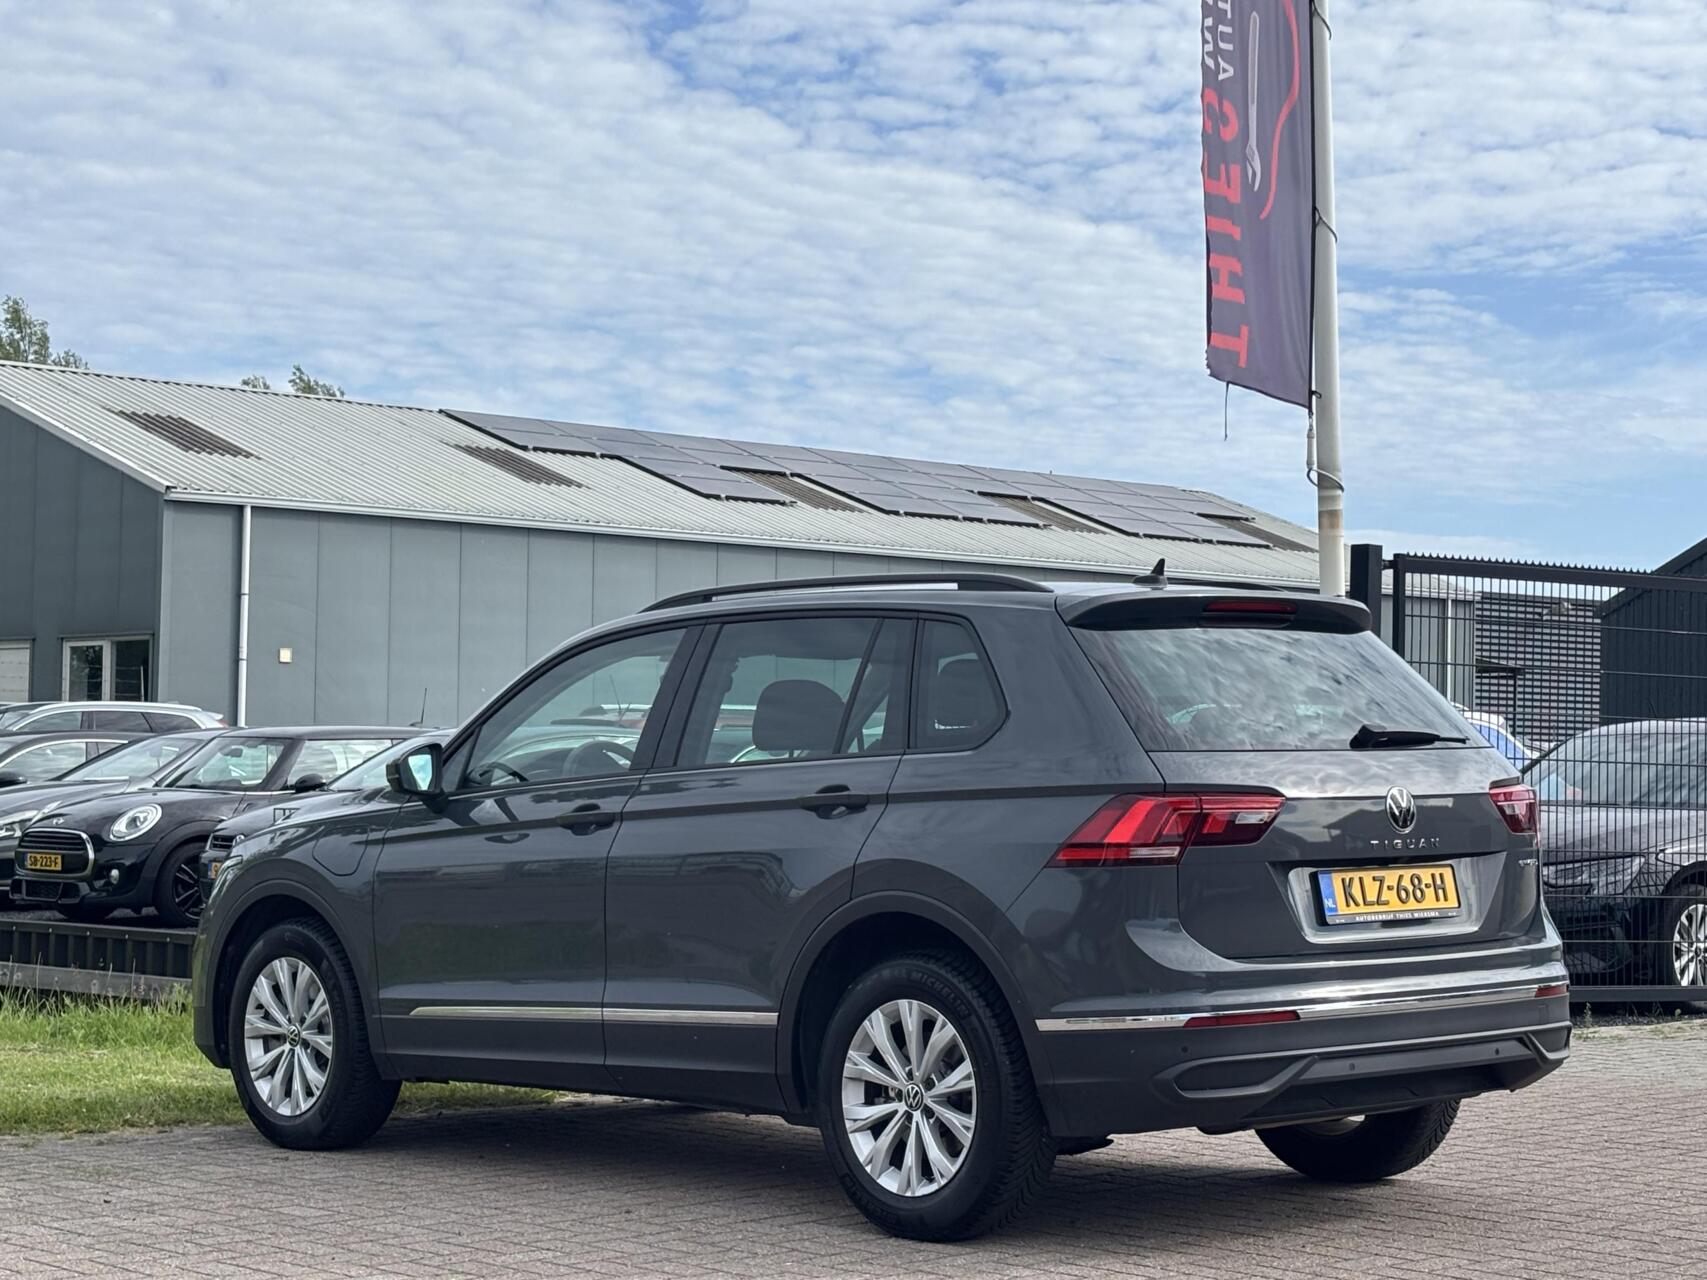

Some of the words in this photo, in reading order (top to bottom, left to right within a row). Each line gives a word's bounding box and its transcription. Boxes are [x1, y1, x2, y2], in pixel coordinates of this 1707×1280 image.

[1370, 838, 1440, 849] TIGUAN
[29, 855, 59, 868] SB-223-F
[1341, 872, 1448, 908] KLZ-68-H
[1324, 898, 1336, 908] NL
